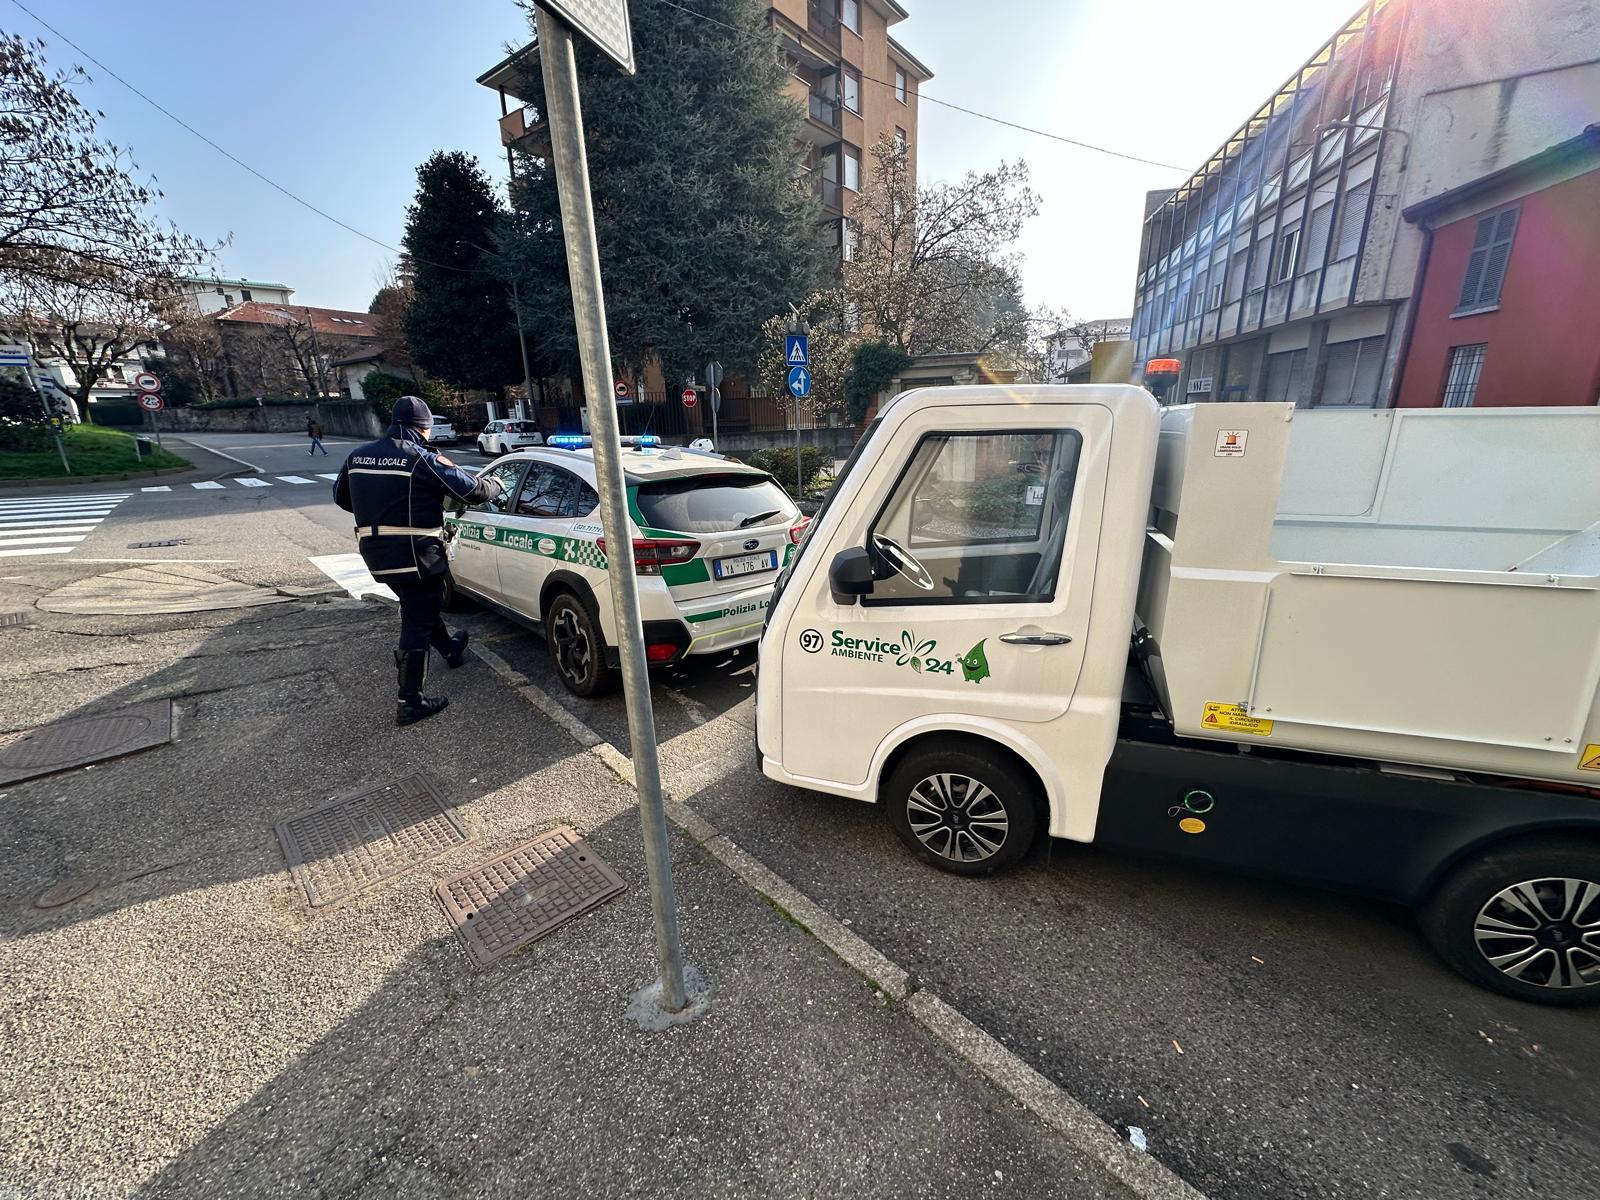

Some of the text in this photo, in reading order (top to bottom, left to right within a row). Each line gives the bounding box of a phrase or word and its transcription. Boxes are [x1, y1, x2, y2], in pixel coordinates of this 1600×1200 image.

[352, 456, 407, 466] POLIZIA LOCALE
[459, 523, 533, 550] Polizia Locale
[725, 558, 769, 575] YA 176 AV
[723, 603, 756, 617] Polizia
[803, 633, 820, 649] 97
[831, 630, 954, 675] Service 24
[831, 647, 884, 663] AMBIENTE
